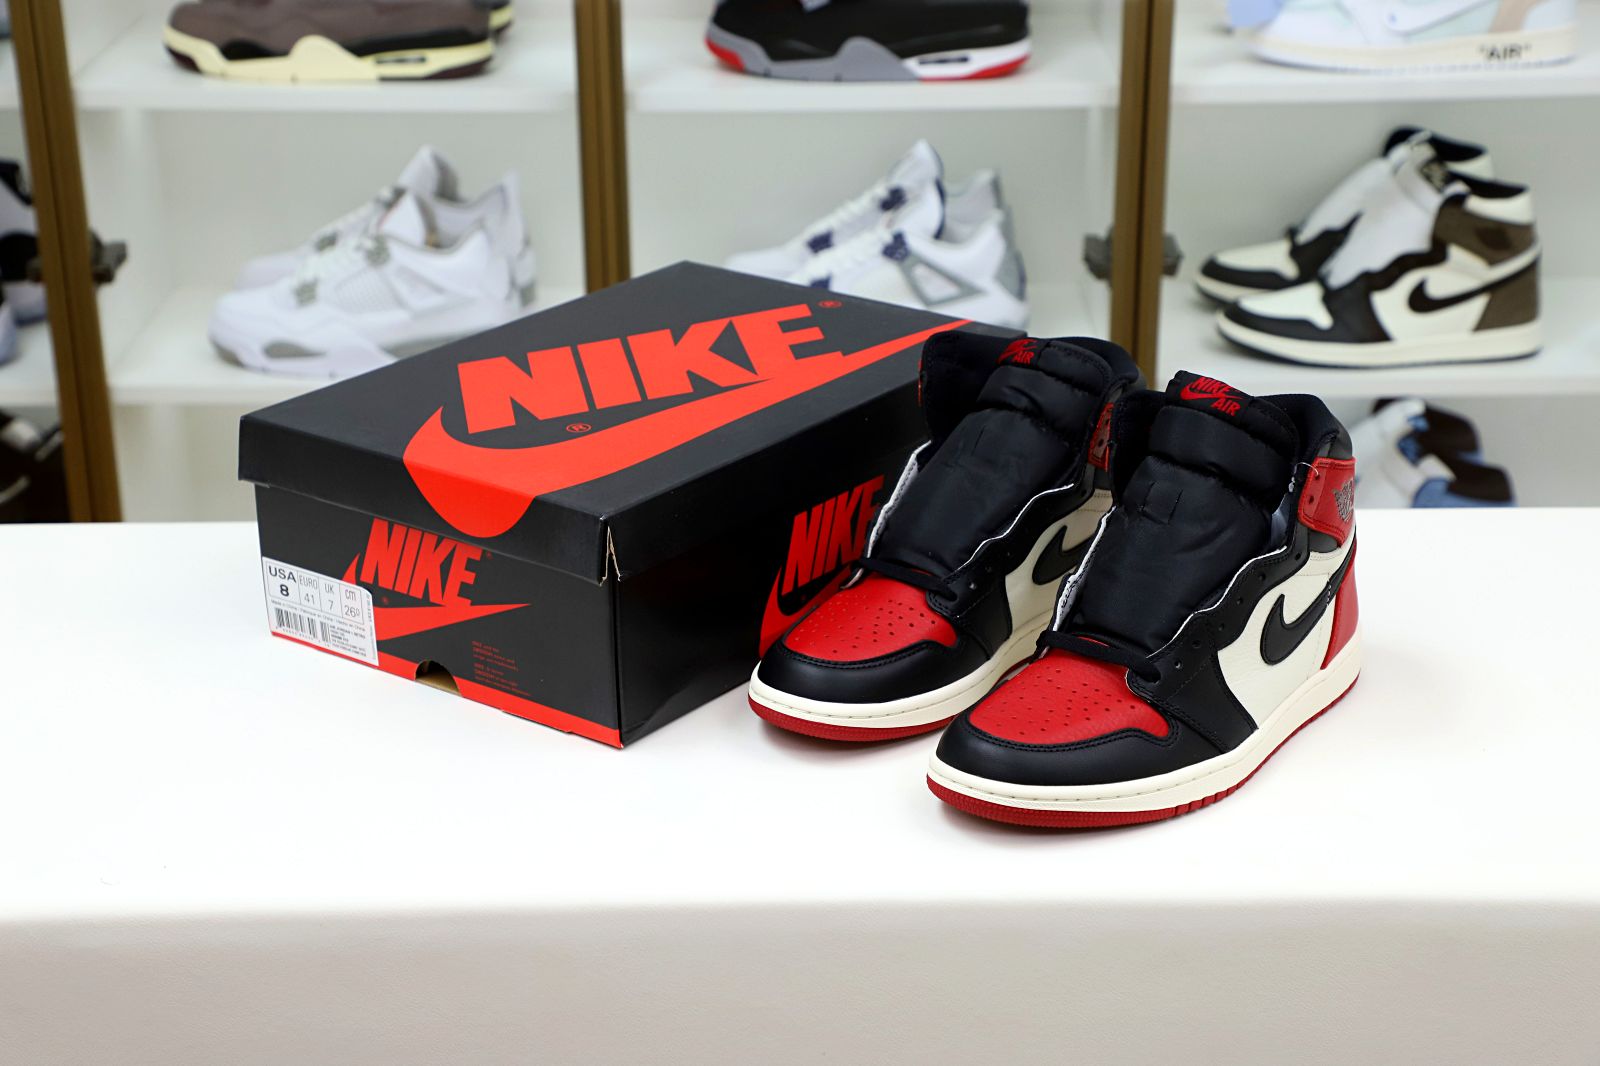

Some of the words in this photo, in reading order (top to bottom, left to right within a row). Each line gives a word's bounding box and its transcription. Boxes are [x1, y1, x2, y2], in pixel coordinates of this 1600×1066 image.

[457, 303, 844, 434] NIKE
[1012, 351, 1035, 365] AIR
[1190, 376, 1233, 394] NIKE
[1210, 398, 1241, 417] AIR
[781, 474, 885, 597] NIKE
[360, 518, 483, 607] NIKE
[268, 566, 297, 583] USA
[299, 575, 318, 590] EURO
[324, 583, 335, 595] UK
[344, 589, 357, 601] cm
[280, 584, 290, 597] 8
[304, 593, 315, 605] 41
[328, 599, 334, 611] 7
